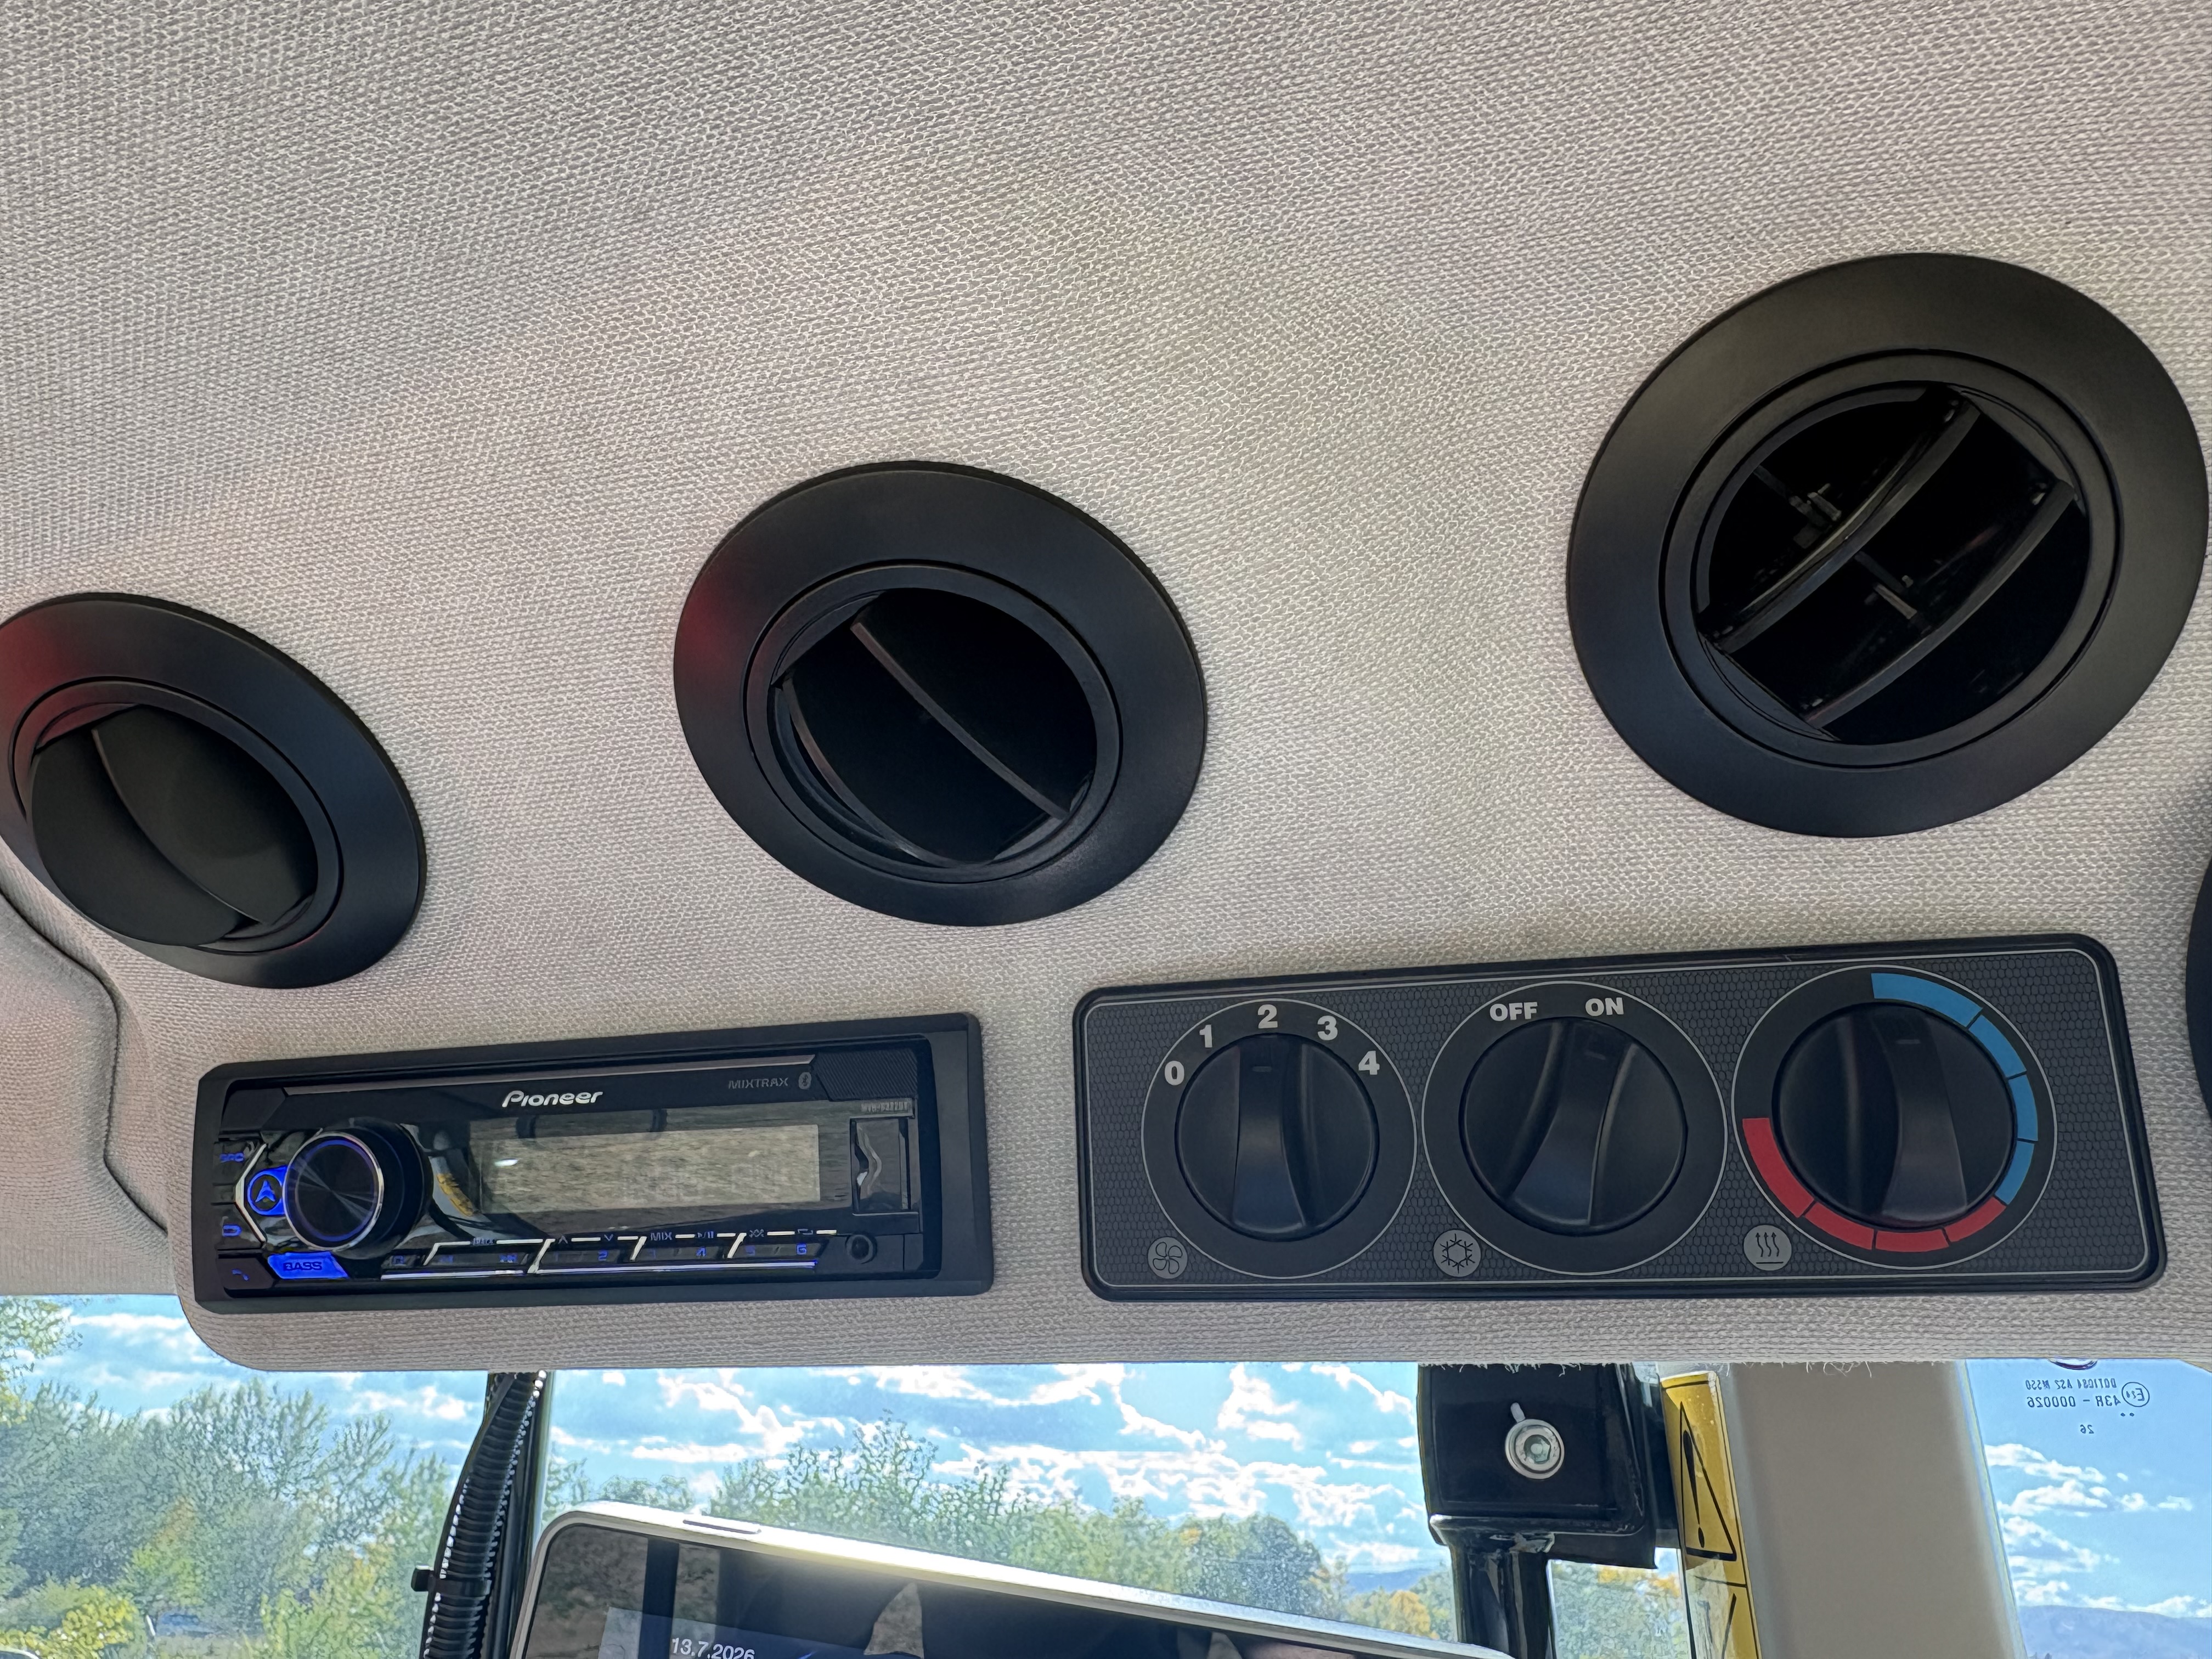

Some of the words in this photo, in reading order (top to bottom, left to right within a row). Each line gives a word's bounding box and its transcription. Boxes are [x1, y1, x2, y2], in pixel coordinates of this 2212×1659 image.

[1489, 1002, 1538, 1022] OFF
[1585, 997, 1624, 1017] ON
[1164, 1060, 1185, 1085] 0
[1199, 1024, 1212, 1048] 1
[1257, 1005, 1278, 1029] 2
[1317, 1015, 1338, 1040] 3
[1358, 1051, 1380, 1075] 4
[728, 1077, 789, 1090] MIXTRAX
[502, 1090, 603, 1108] Pioneer
[651, 1232, 673, 1241] MIX
[597, 1250, 609, 1261] 2
[795, 1244, 807, 1255] 6
[283, 1261, 323, 1271] BASS
[672, 1637, 755, 1659] 13.7.2026
